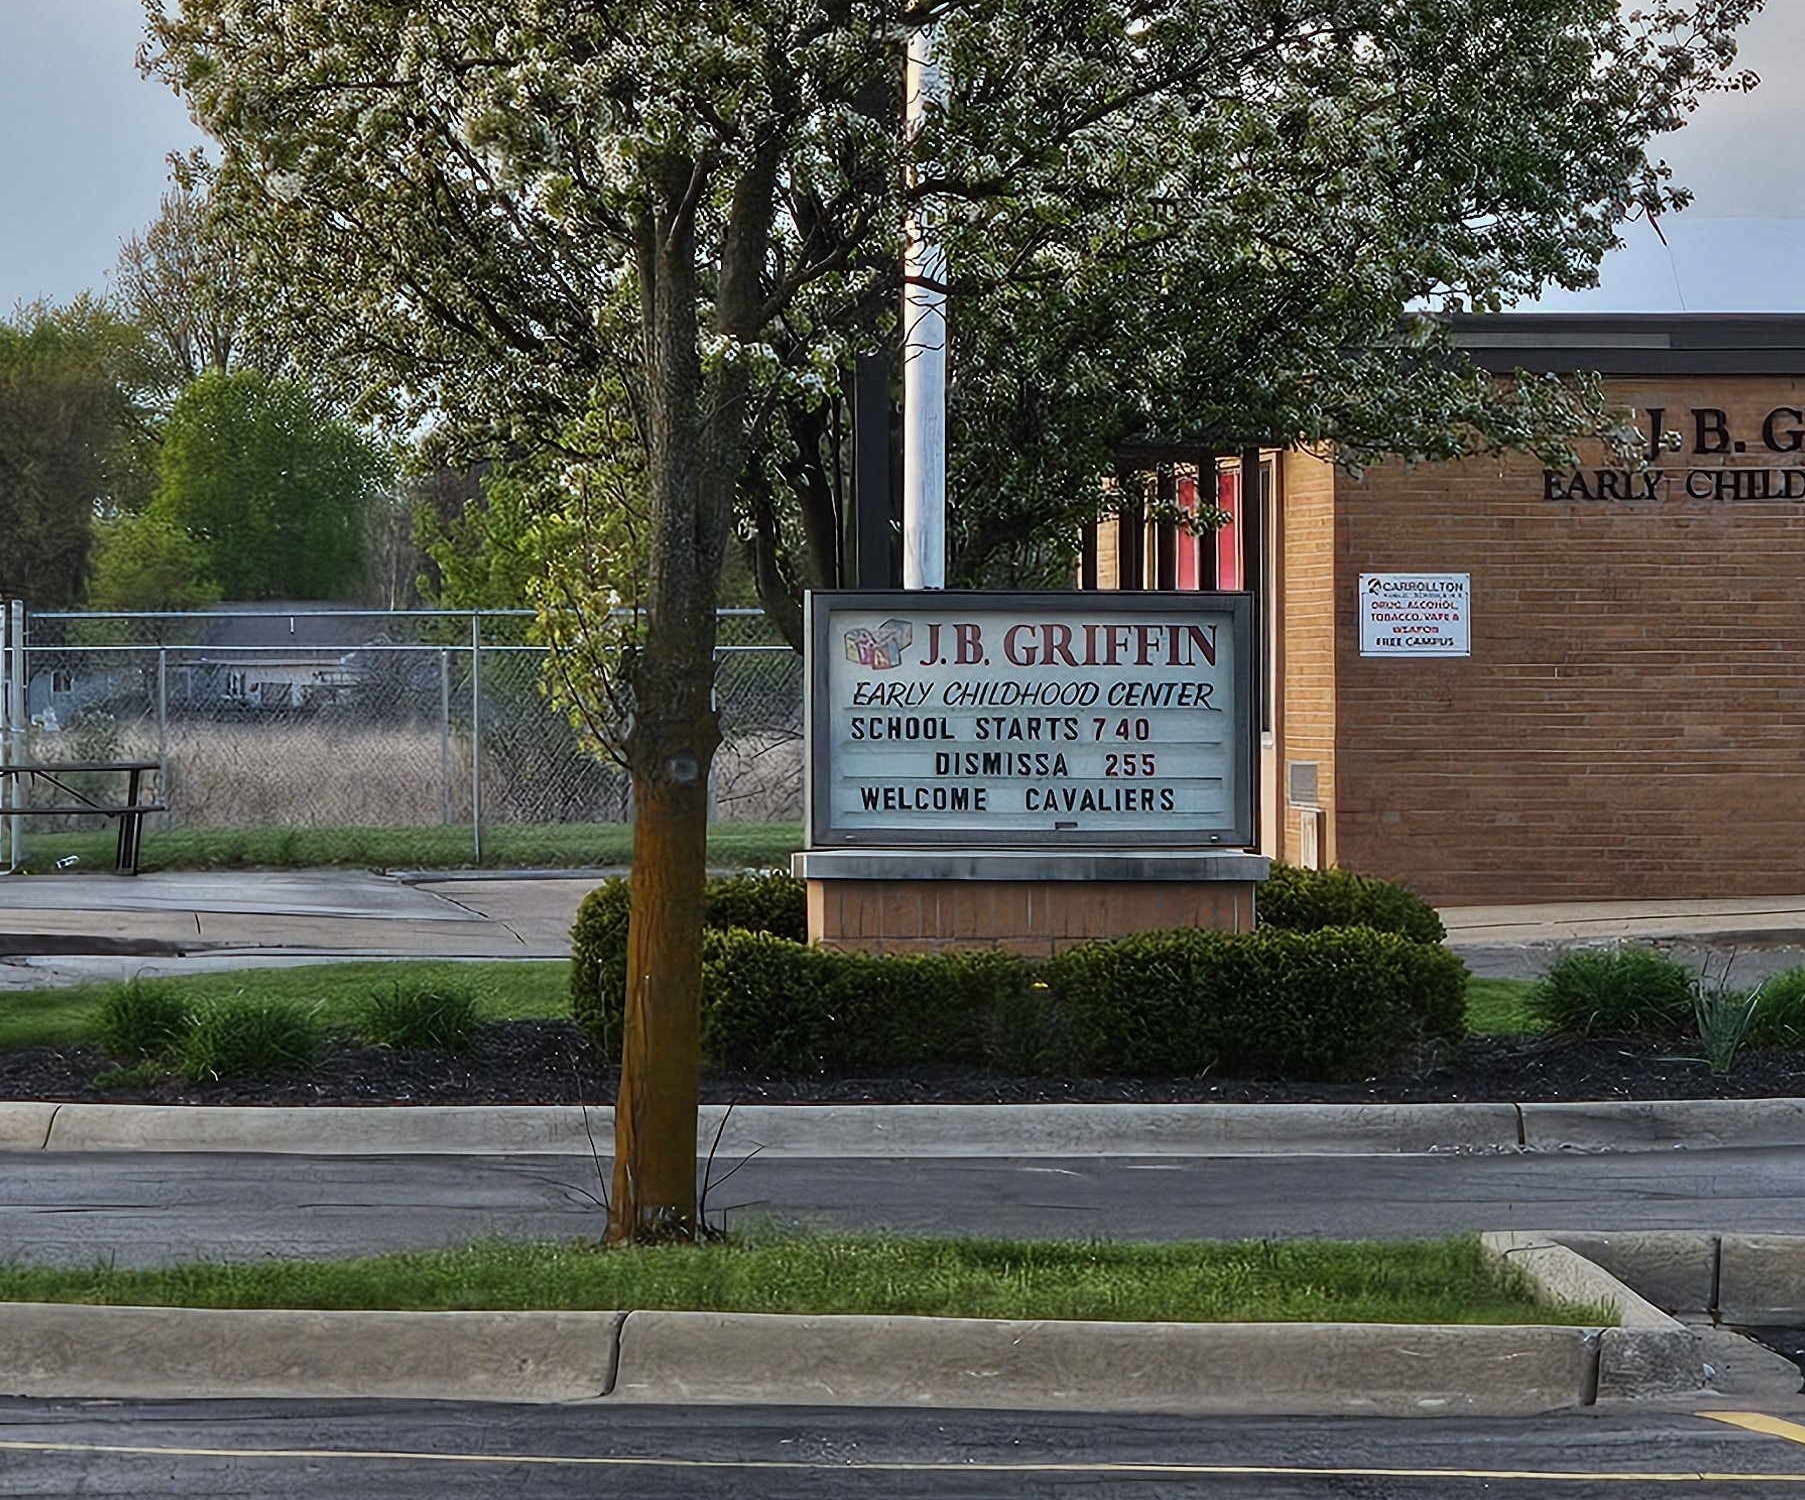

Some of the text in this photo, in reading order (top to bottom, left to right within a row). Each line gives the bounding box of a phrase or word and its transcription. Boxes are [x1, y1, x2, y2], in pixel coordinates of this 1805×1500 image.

[1543, 469, 1665, 501] EARLY
[1383, 582, 1463, 593] CARROLLTON
[1003, 623, 1218, 668] GRIFFIN
[1376, 637, 1454, 647] FREE CAMPUS
[853, 681, 1222, 711] EARLY CHILDHOOD CENTER
[851, 716, 955, 741] SCHOOL
[975, 716, 1079, 741] STARTS
[936, 751, 1156, 777] DISMISSA 255
[861, 786, 1175, 812] WELCOME CAVALIERS
